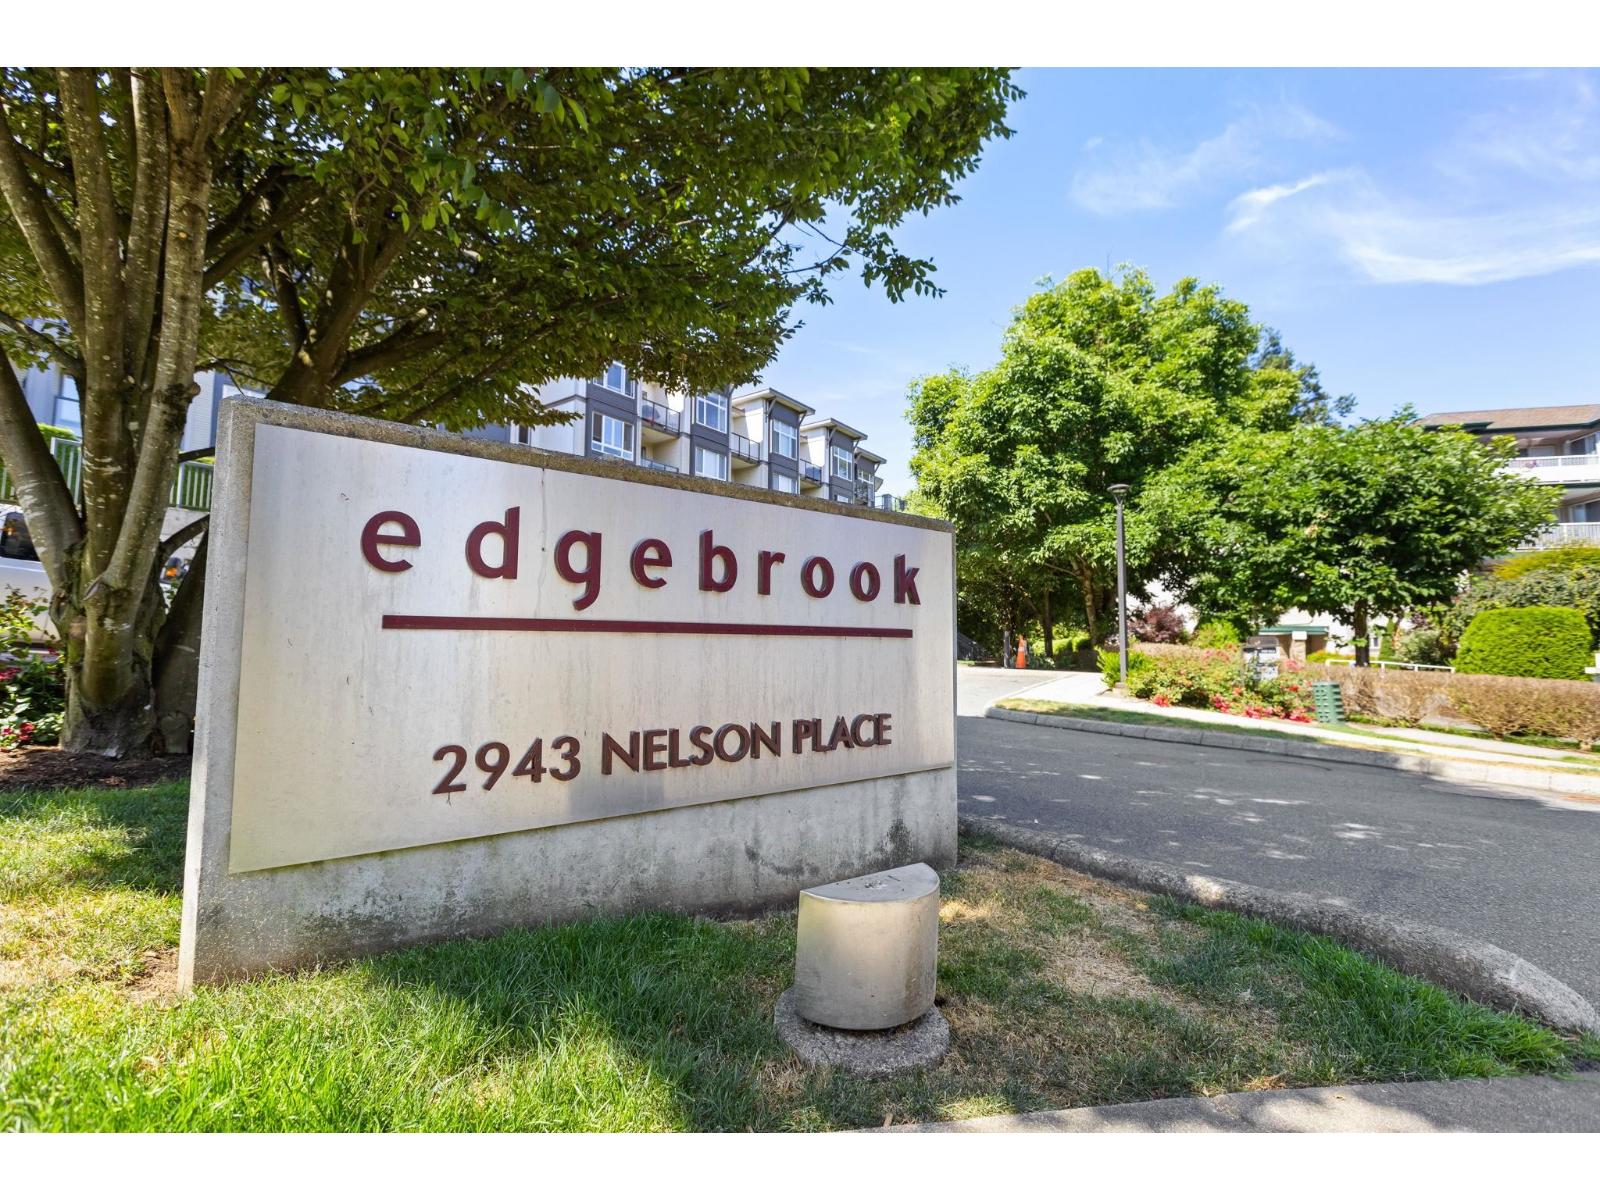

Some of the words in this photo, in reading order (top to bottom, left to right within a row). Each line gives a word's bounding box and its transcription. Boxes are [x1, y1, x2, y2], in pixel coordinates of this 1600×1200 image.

[360, 505, 921, 611] edgebrook
[432, 735, 581, 795] 2943
[601, 720, 782, 775] NELSON
[792, 713, 893, 755] PLACE
